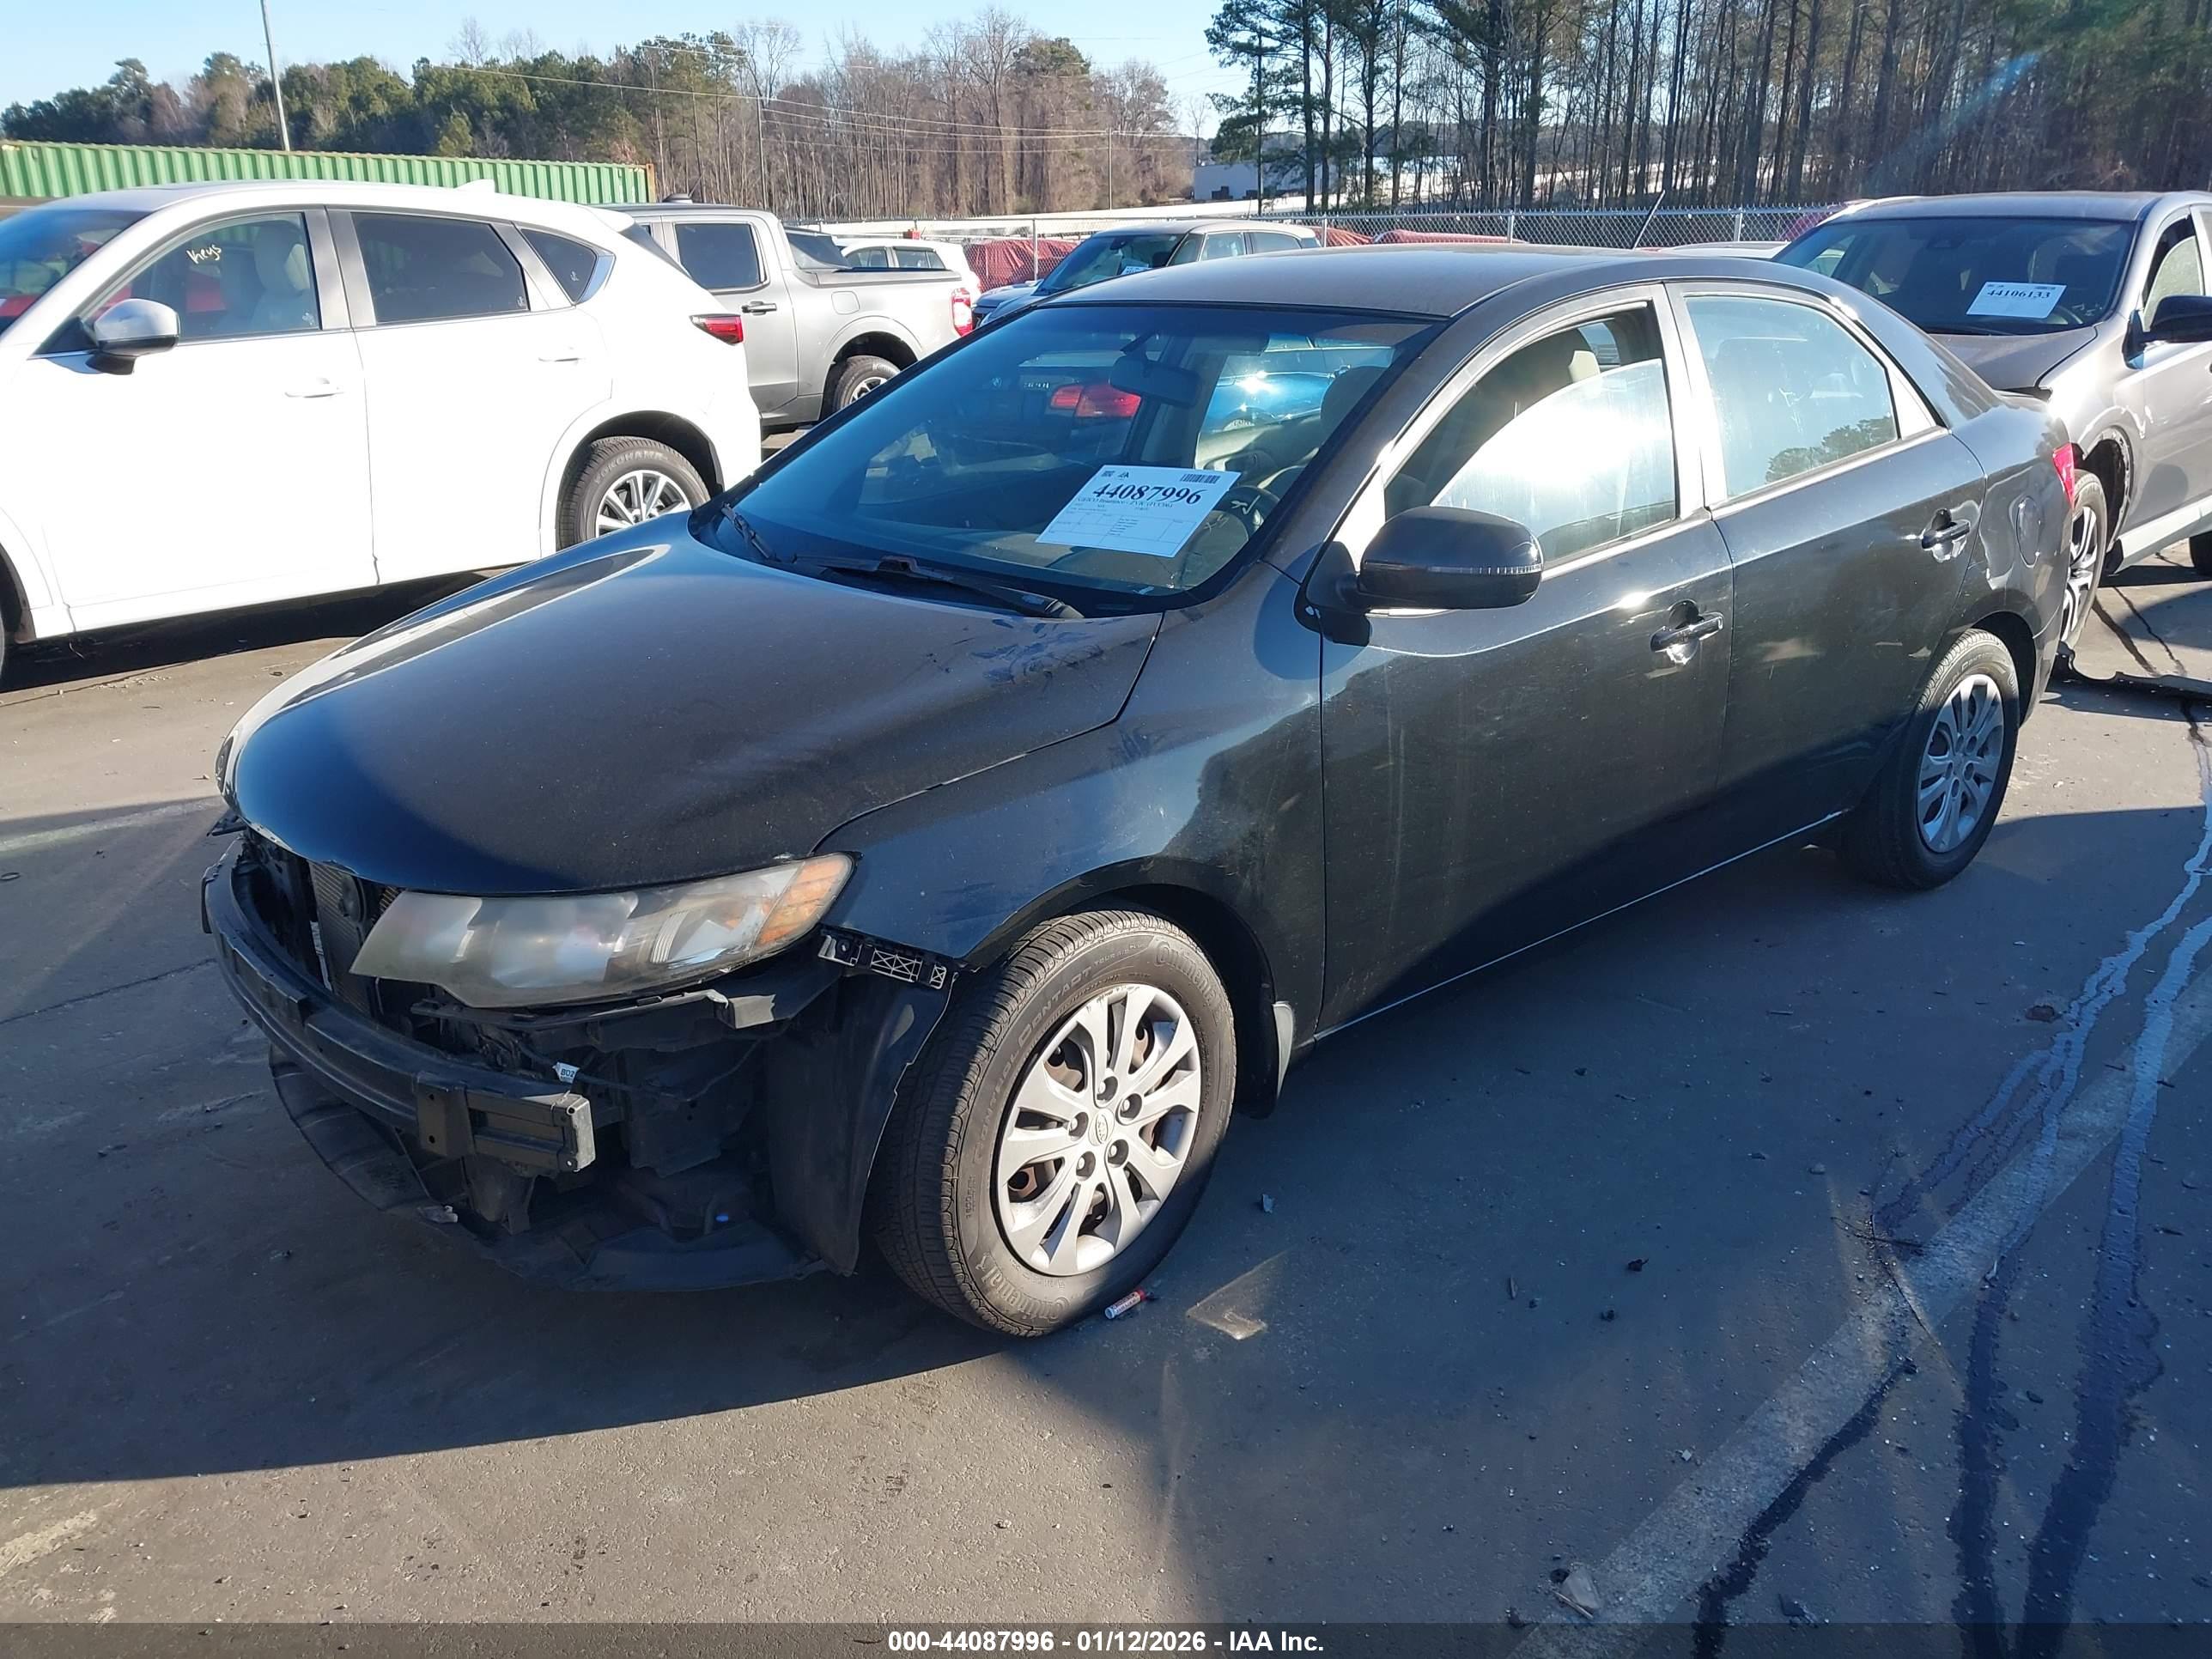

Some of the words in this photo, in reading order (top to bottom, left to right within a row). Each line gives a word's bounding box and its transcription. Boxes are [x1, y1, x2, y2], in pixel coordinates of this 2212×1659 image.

[1987, 289, 2051, 299] 44106133
[595, 450, 662, 483] YOKOHAMA
[1093, 483, 1207, 505] 44087996
[1018, 966, 1092, 1048] CONTACT
